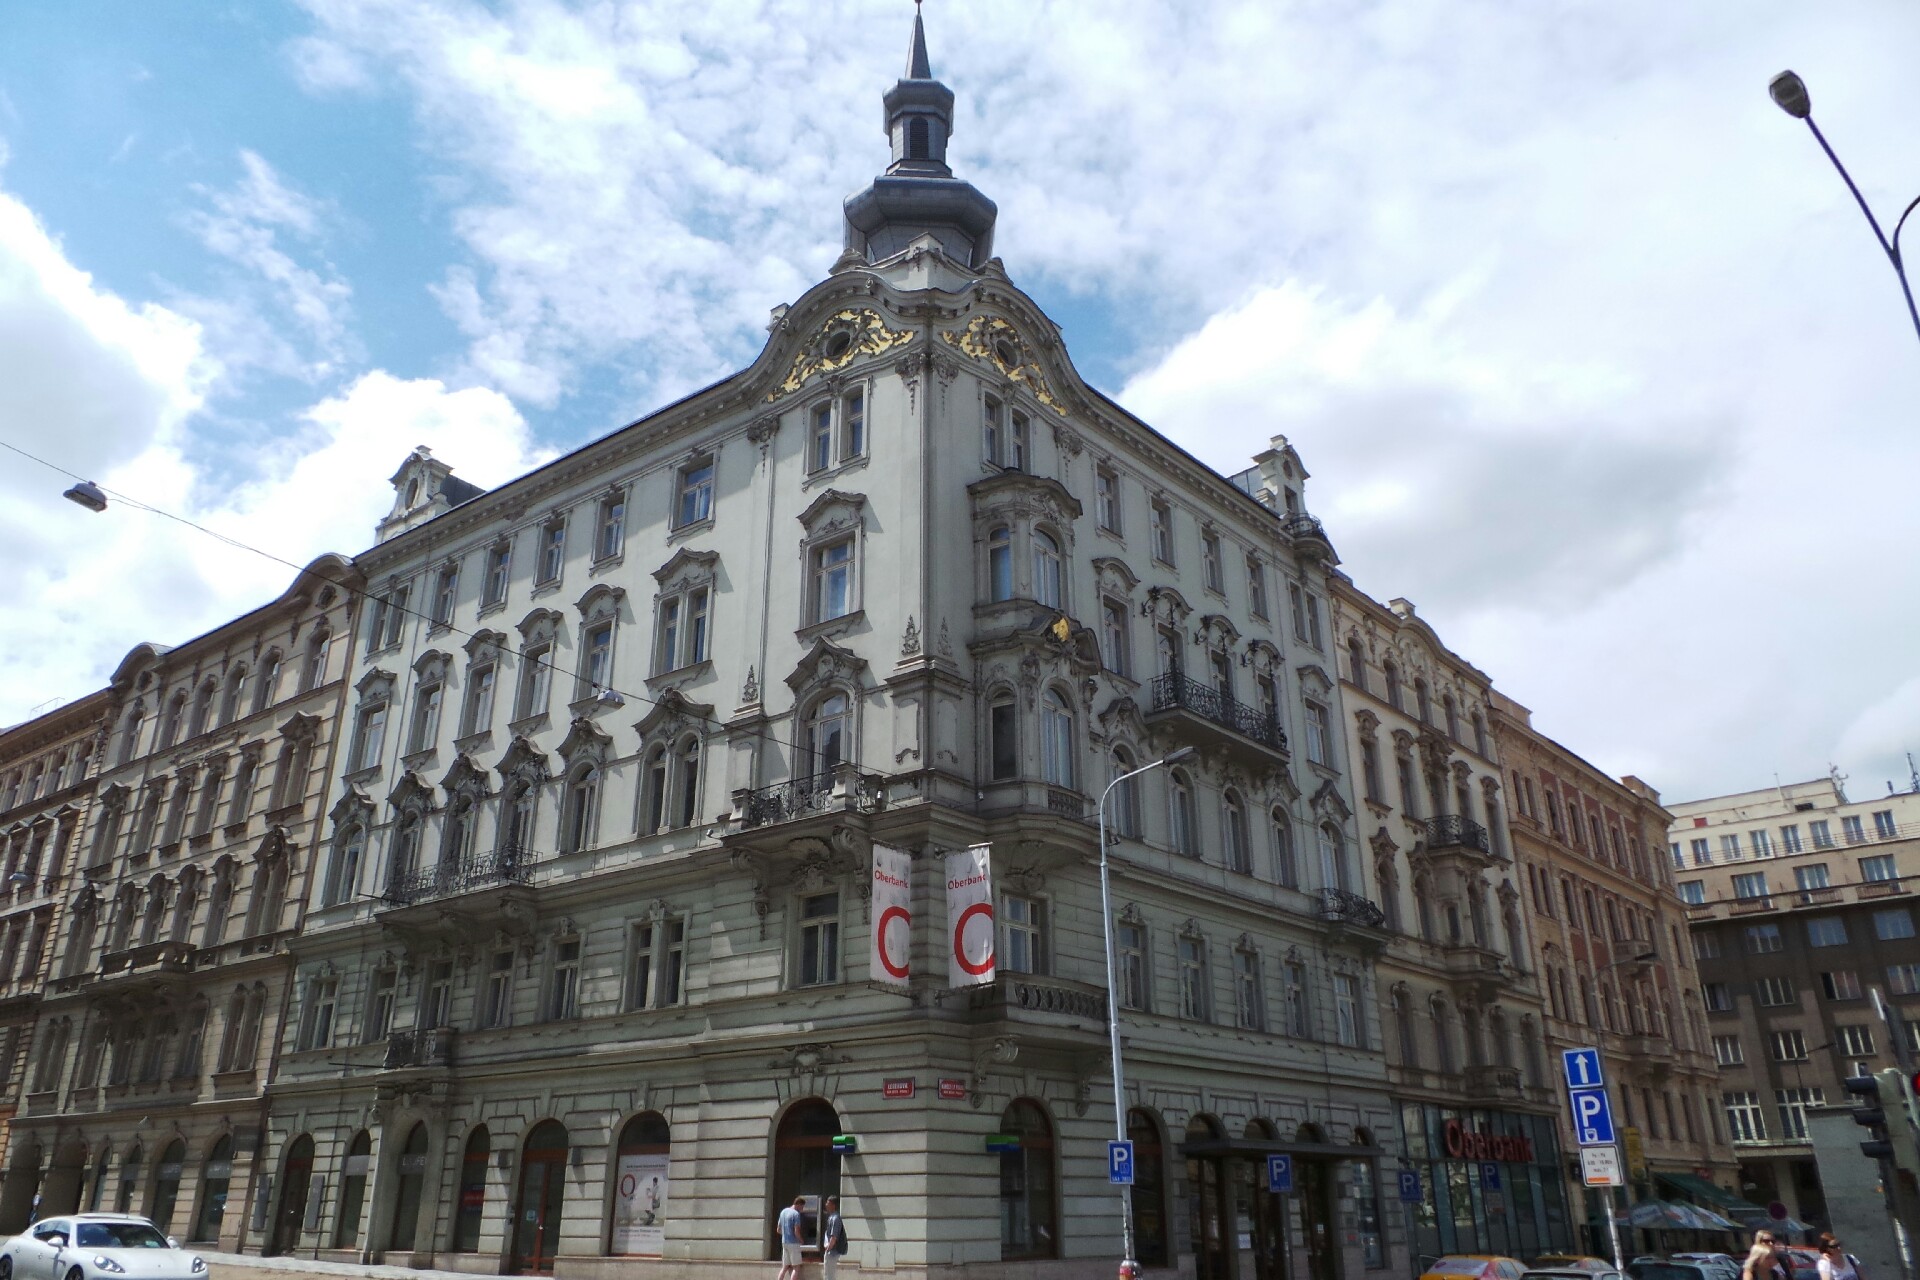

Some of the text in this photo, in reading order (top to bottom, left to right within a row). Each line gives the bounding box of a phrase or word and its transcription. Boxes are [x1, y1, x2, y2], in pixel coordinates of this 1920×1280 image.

[875, 870, 909, 889] Oberbank
[1579, 1095, 1601, 1128] P
[1446, 1118, 1535, 1162] Oberbank
[1113, 1147, 1128, 1172] P
[1272, 1159, 1286, 1181] P
